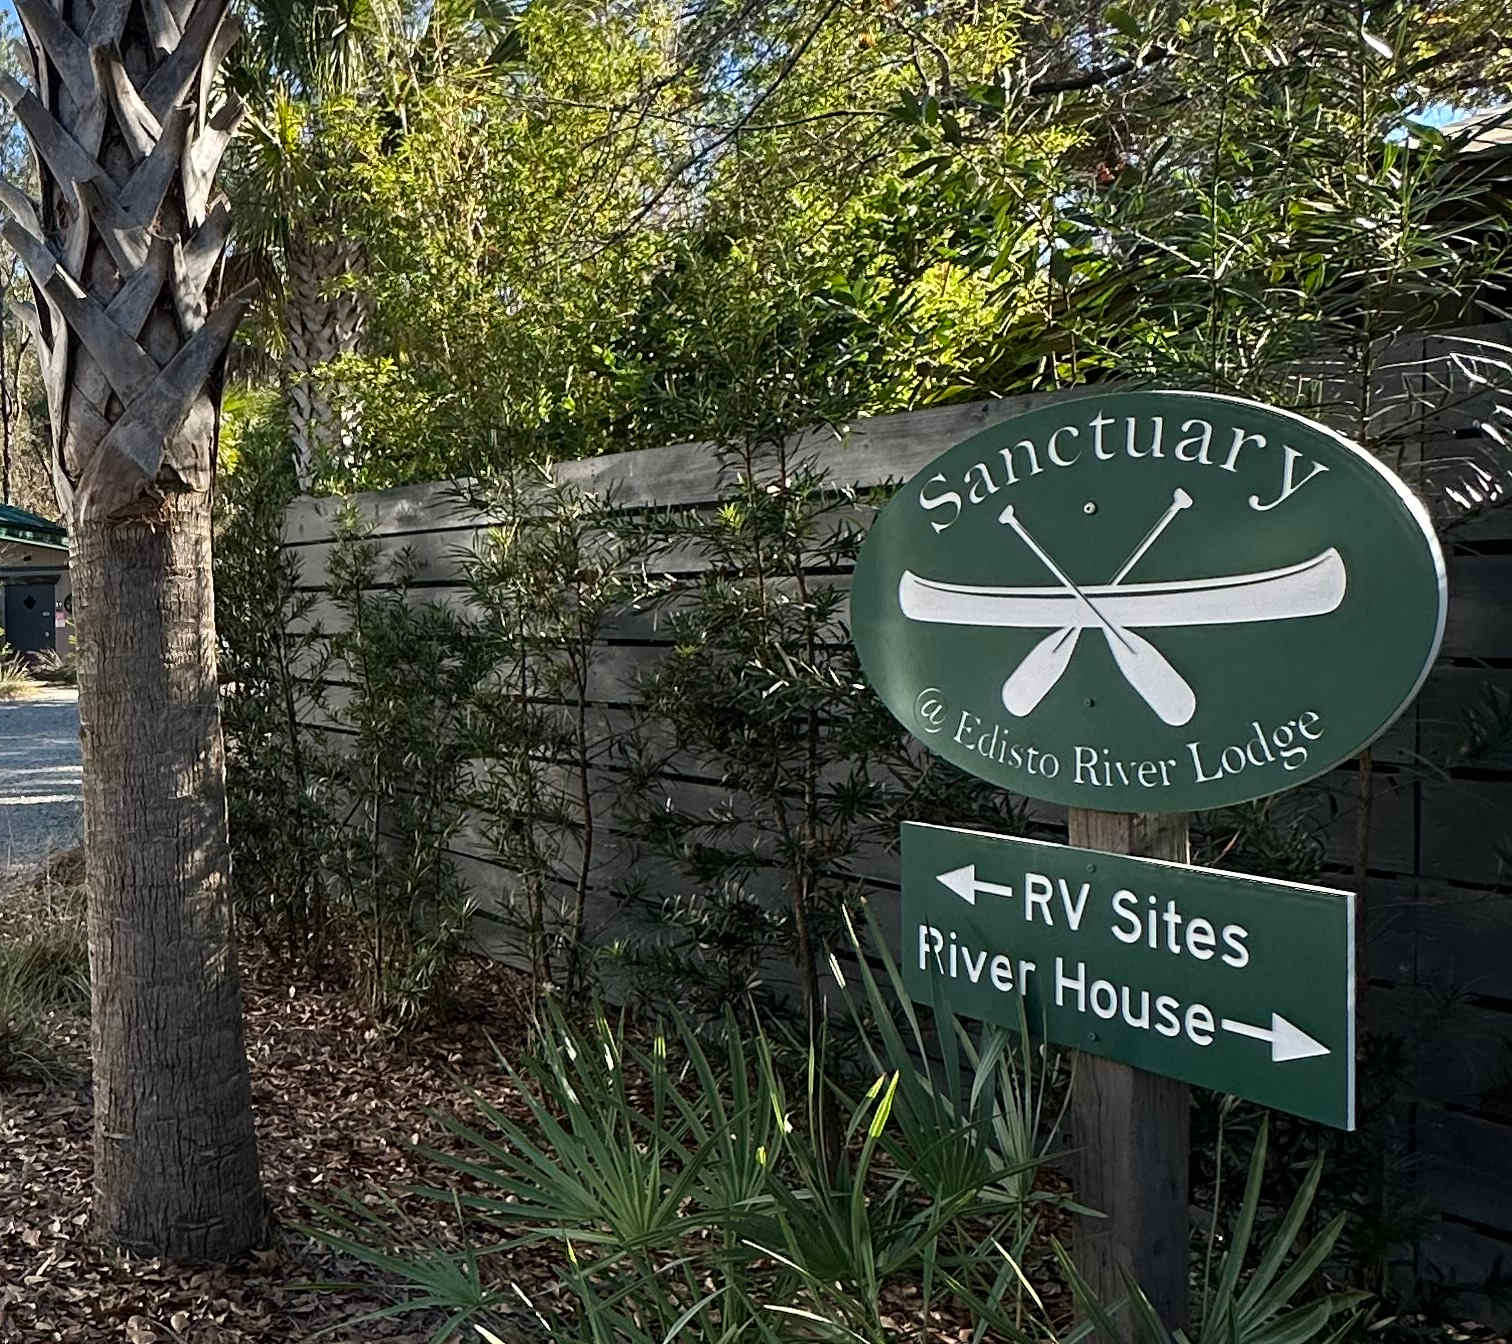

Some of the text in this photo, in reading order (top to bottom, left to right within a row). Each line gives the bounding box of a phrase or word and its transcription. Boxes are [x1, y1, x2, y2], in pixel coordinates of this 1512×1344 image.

[919, 410, 1330, 533] Sanctuary
[914, 687, 1325, 787] @ Edisto River Lodge
[1024, 872, 1250, 968] RV Sites
[919, 924, 1216, 1046] River House
